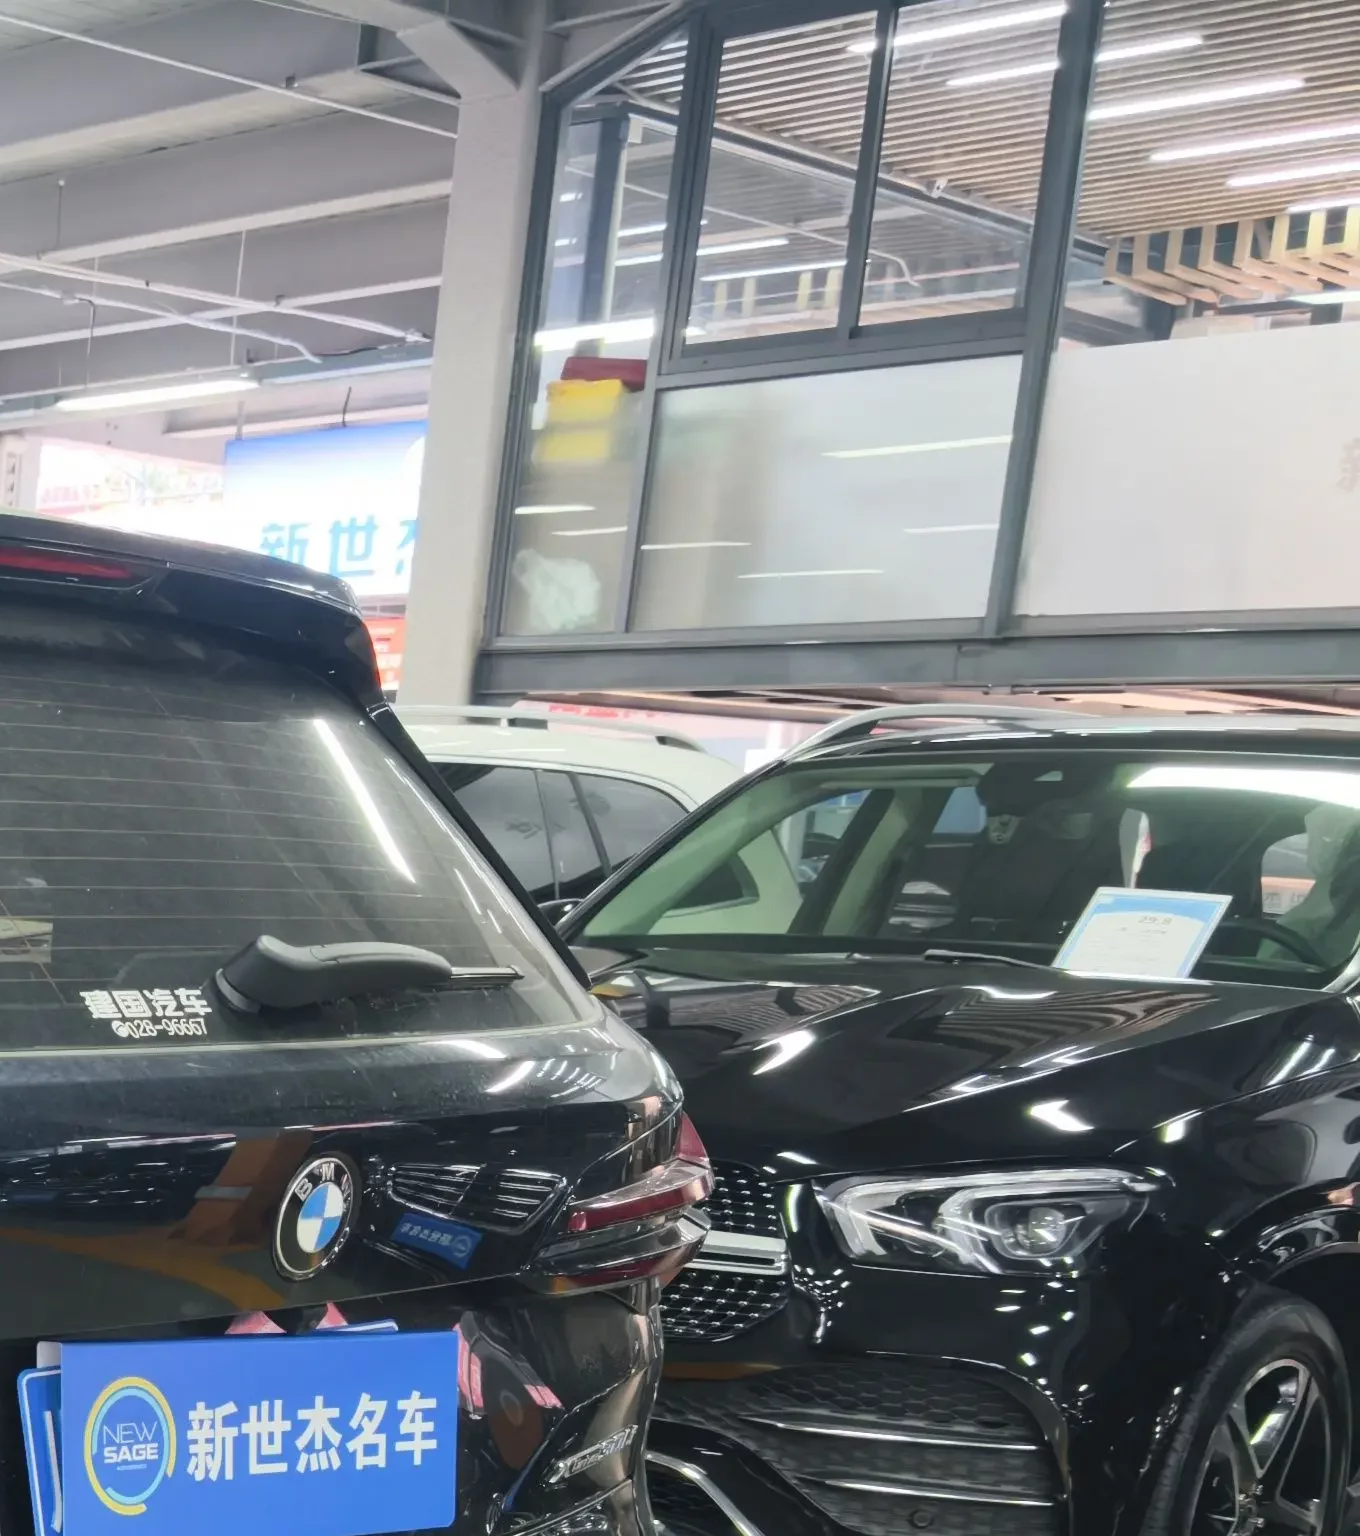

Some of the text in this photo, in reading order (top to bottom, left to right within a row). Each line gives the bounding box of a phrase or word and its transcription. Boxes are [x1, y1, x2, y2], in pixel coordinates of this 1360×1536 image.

[79, 987, 213, 1019] 建国汽车
[103, 1420, 158, 1445] NEW
[186, 1389, 438, 1482] 新世杰名车
[103, 1442, 159, 1464] SAGE
